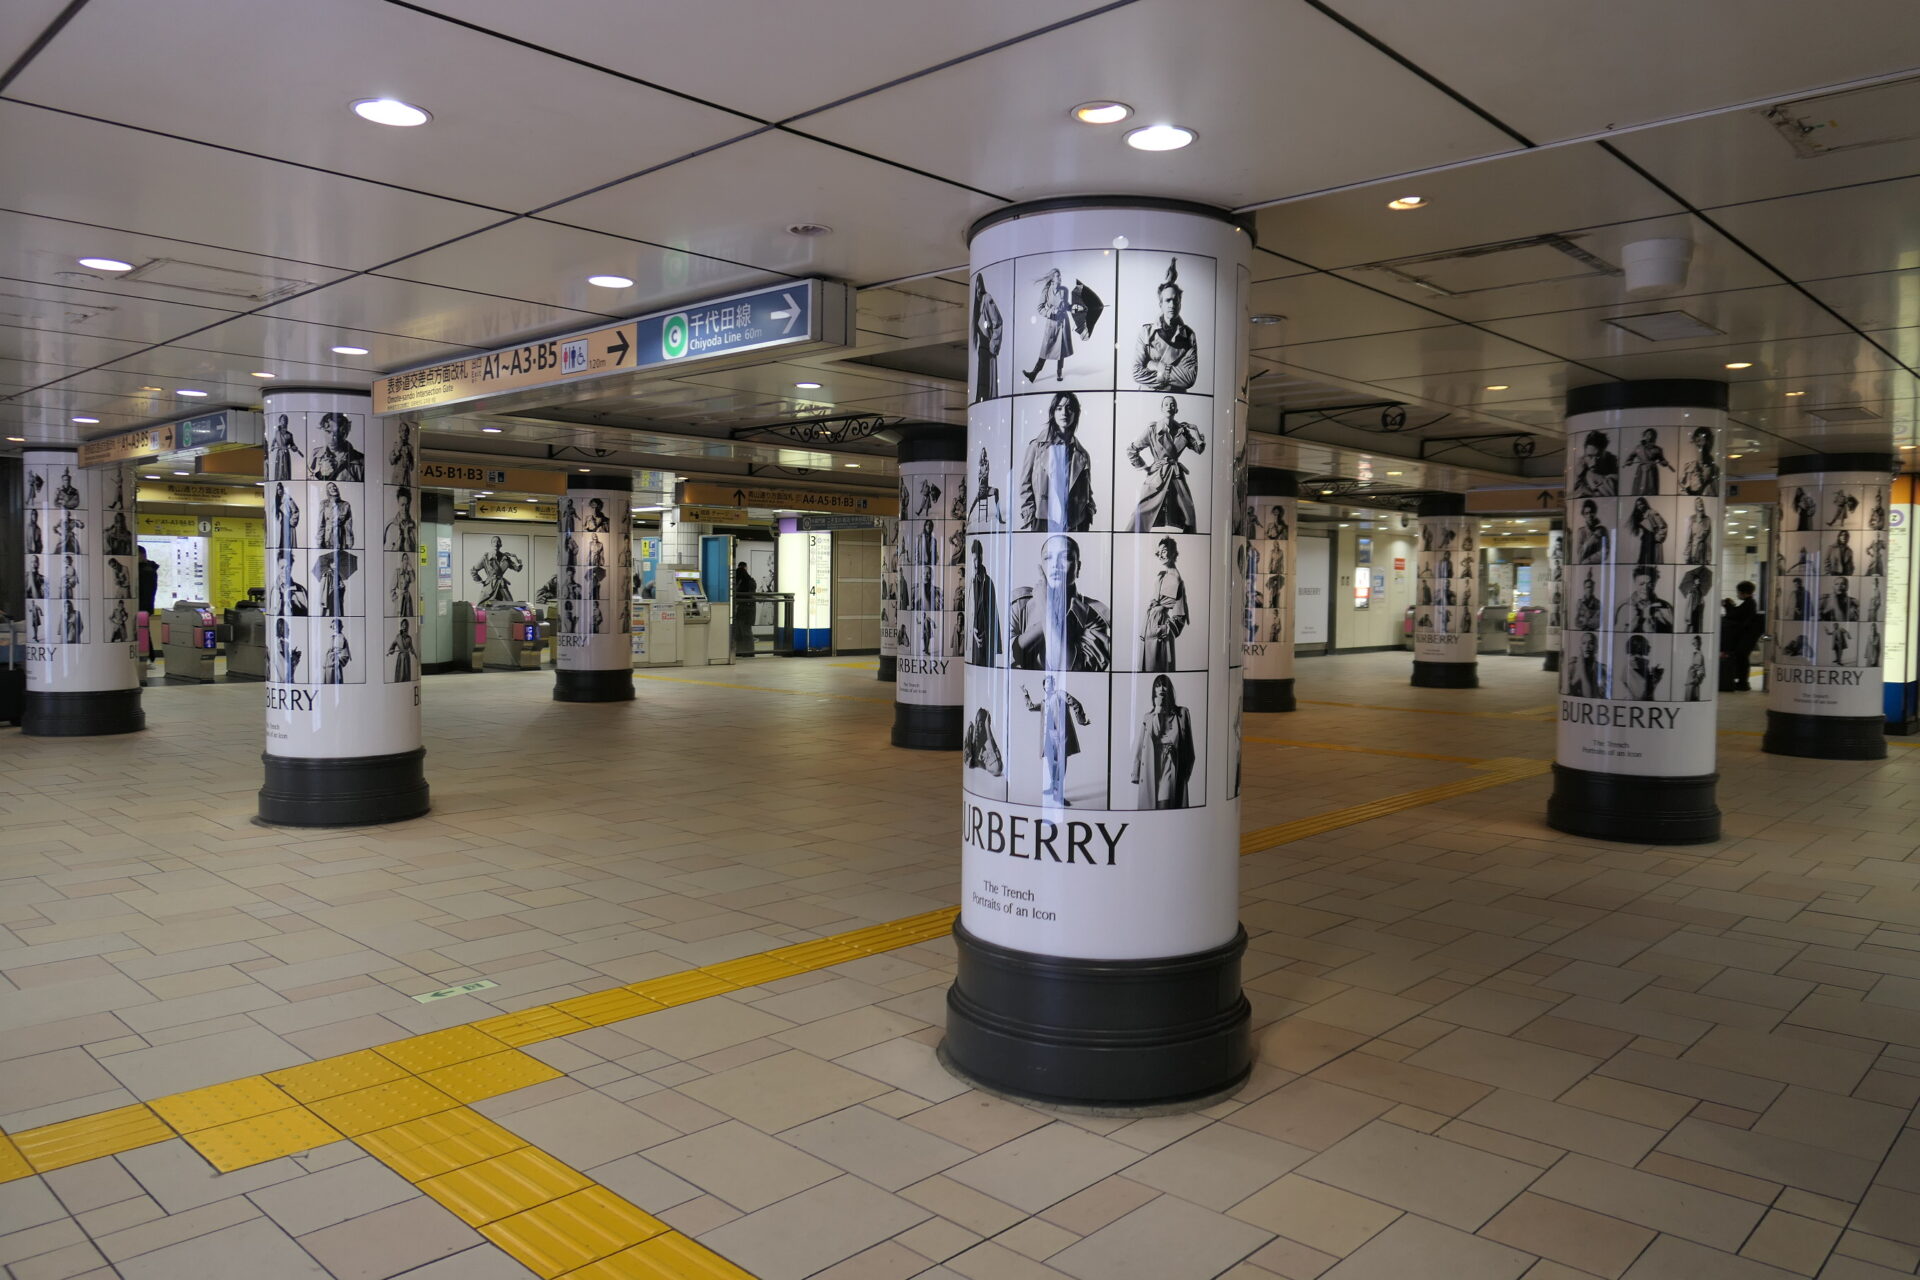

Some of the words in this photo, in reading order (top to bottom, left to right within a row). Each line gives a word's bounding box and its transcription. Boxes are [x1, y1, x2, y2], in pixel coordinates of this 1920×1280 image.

[690, 303, 751, 337] 千代田線
[689, 334, 722, 351] Chiyoda
[724, 331, 742, 344] Line
[744, 327, 762, 340] 60m
[387, 360, 469, 394] 表参道交差点方面改札
[416, 386, 441, 399] Intersection
[810, 535, 817, 547] 3
[809, 586, 816, 596] 4
[1776, 667, 1864, 686] BURBERRY
[1562, 700, 1680, 730] BURBERRY
[964, 801, 1129, 866] URBERRY
[984, 880, 999, 894] The
[1001, 885, 1035, 902] Trench
[973, 891, 1001, 911] Portraits
[1003, 903, 1013, 914] of
[1016, 907, 1028, 918] an
[1032, 907, 1056, 921] Icon
